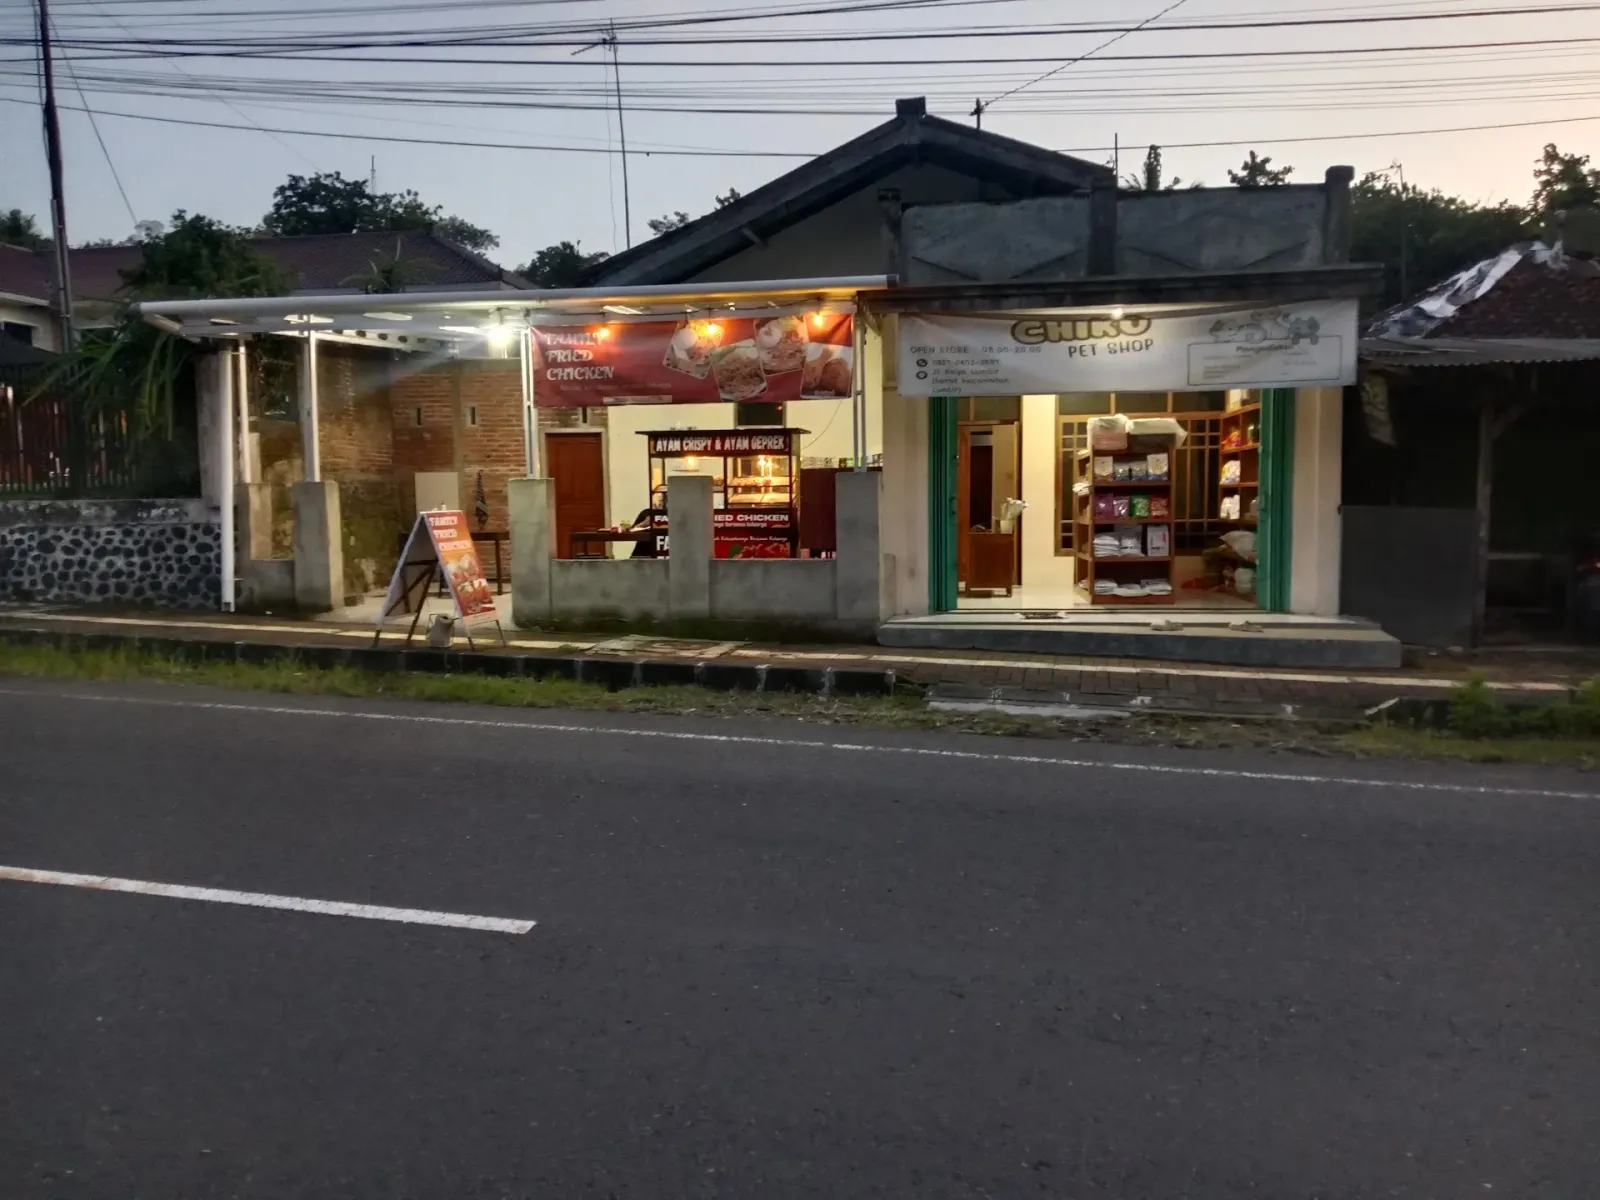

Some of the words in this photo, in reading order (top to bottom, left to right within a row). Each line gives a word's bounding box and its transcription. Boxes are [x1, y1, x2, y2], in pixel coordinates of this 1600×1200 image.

[910, 346, 936, 354] OPEN
[940, 346, 969, 354] STORE
[1068, 344, 1097, 358] PET
[1107, 339, 1154, 355] SHOP
[546, 349, 594, 363] FRIED
[546, 366, 615, 381] CHICKEN
[656, 437, 681, 452] AYAM
[683, 436, 712, 451] CRISPY
[724, 436, 749, 450] AYAM
[751, 435, 784, 450] GEPREK
[714, 514, 734, 522] IED
[736, 514, 789, 522] CHICKEN
